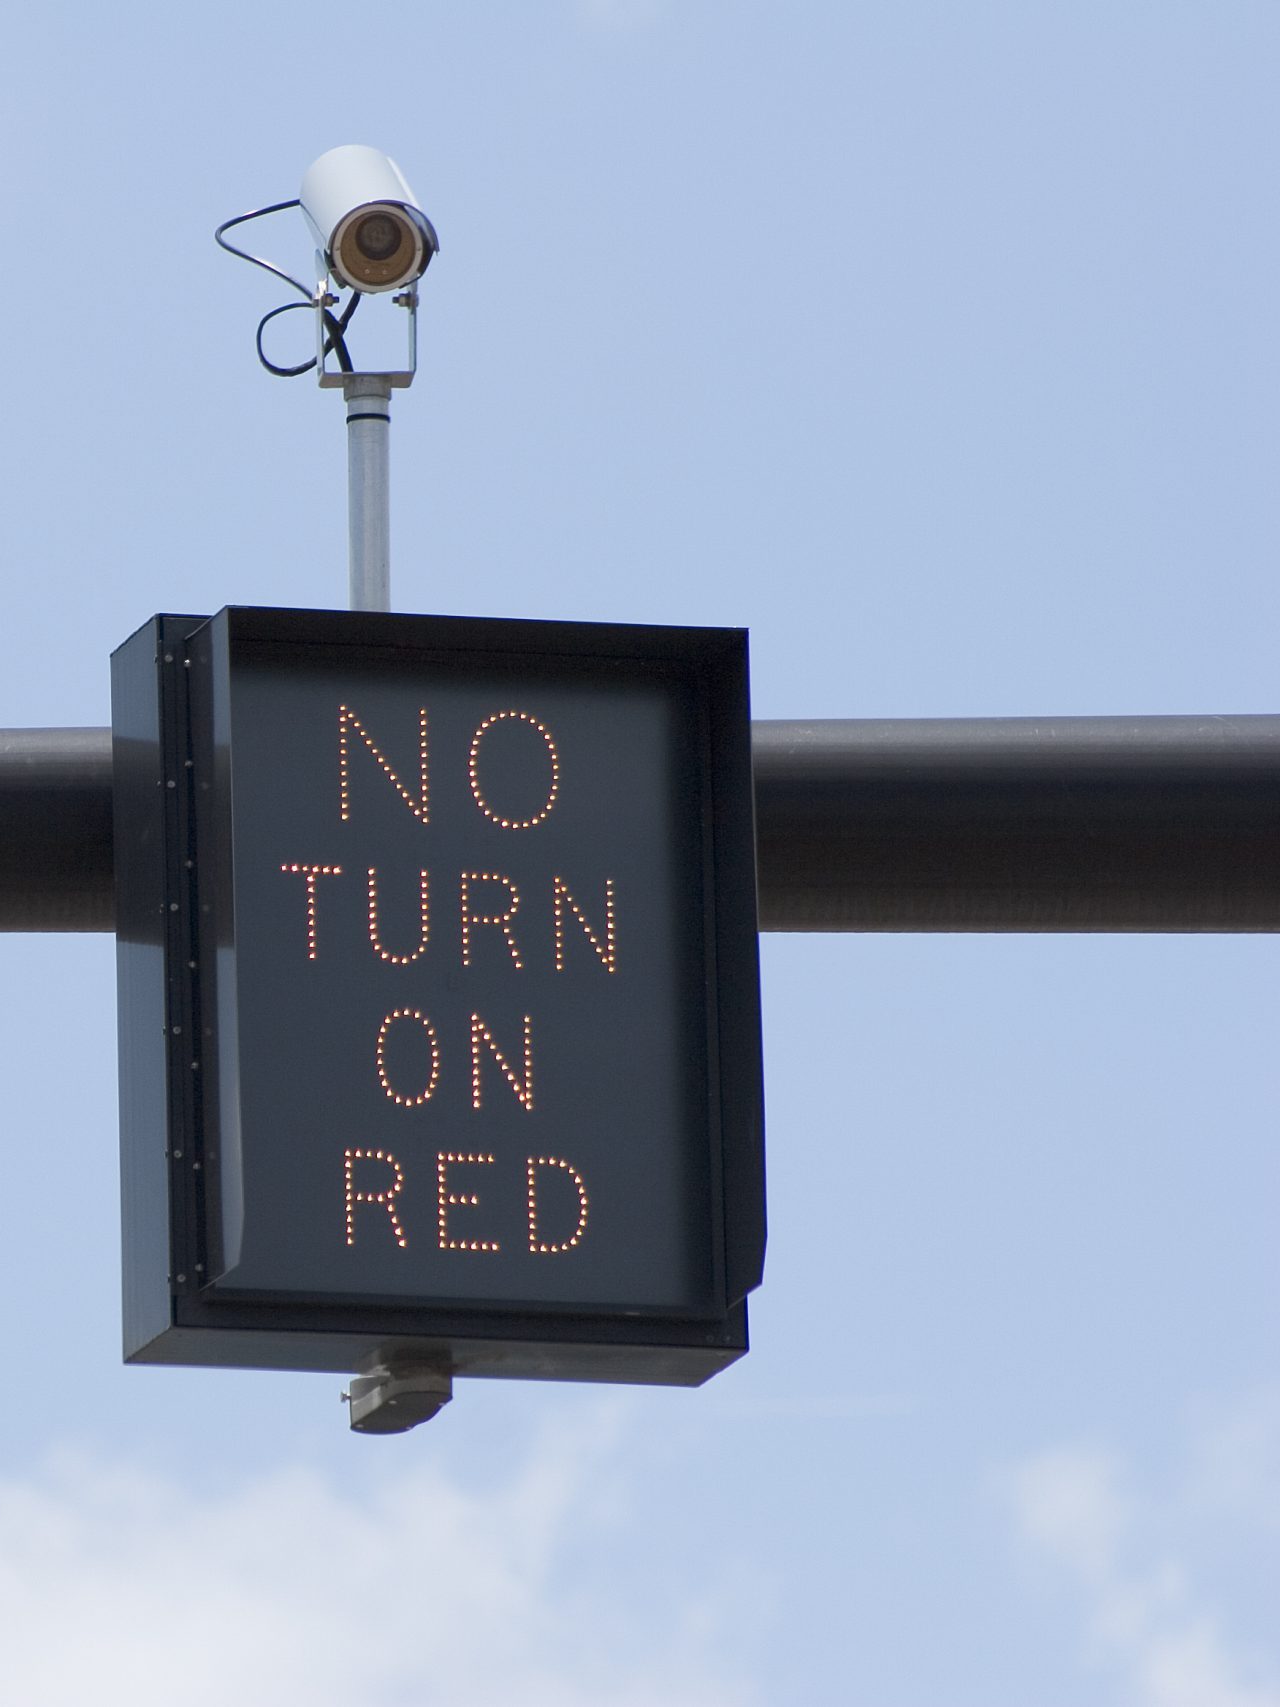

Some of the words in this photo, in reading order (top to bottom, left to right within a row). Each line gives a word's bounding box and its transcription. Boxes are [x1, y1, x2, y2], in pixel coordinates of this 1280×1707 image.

[338, 704, 560, 830] NO
[281, 863, 616, 973] TURN
[375, 1008, 533, 1111] ON
[344, 1148, 588, 1253] RED
